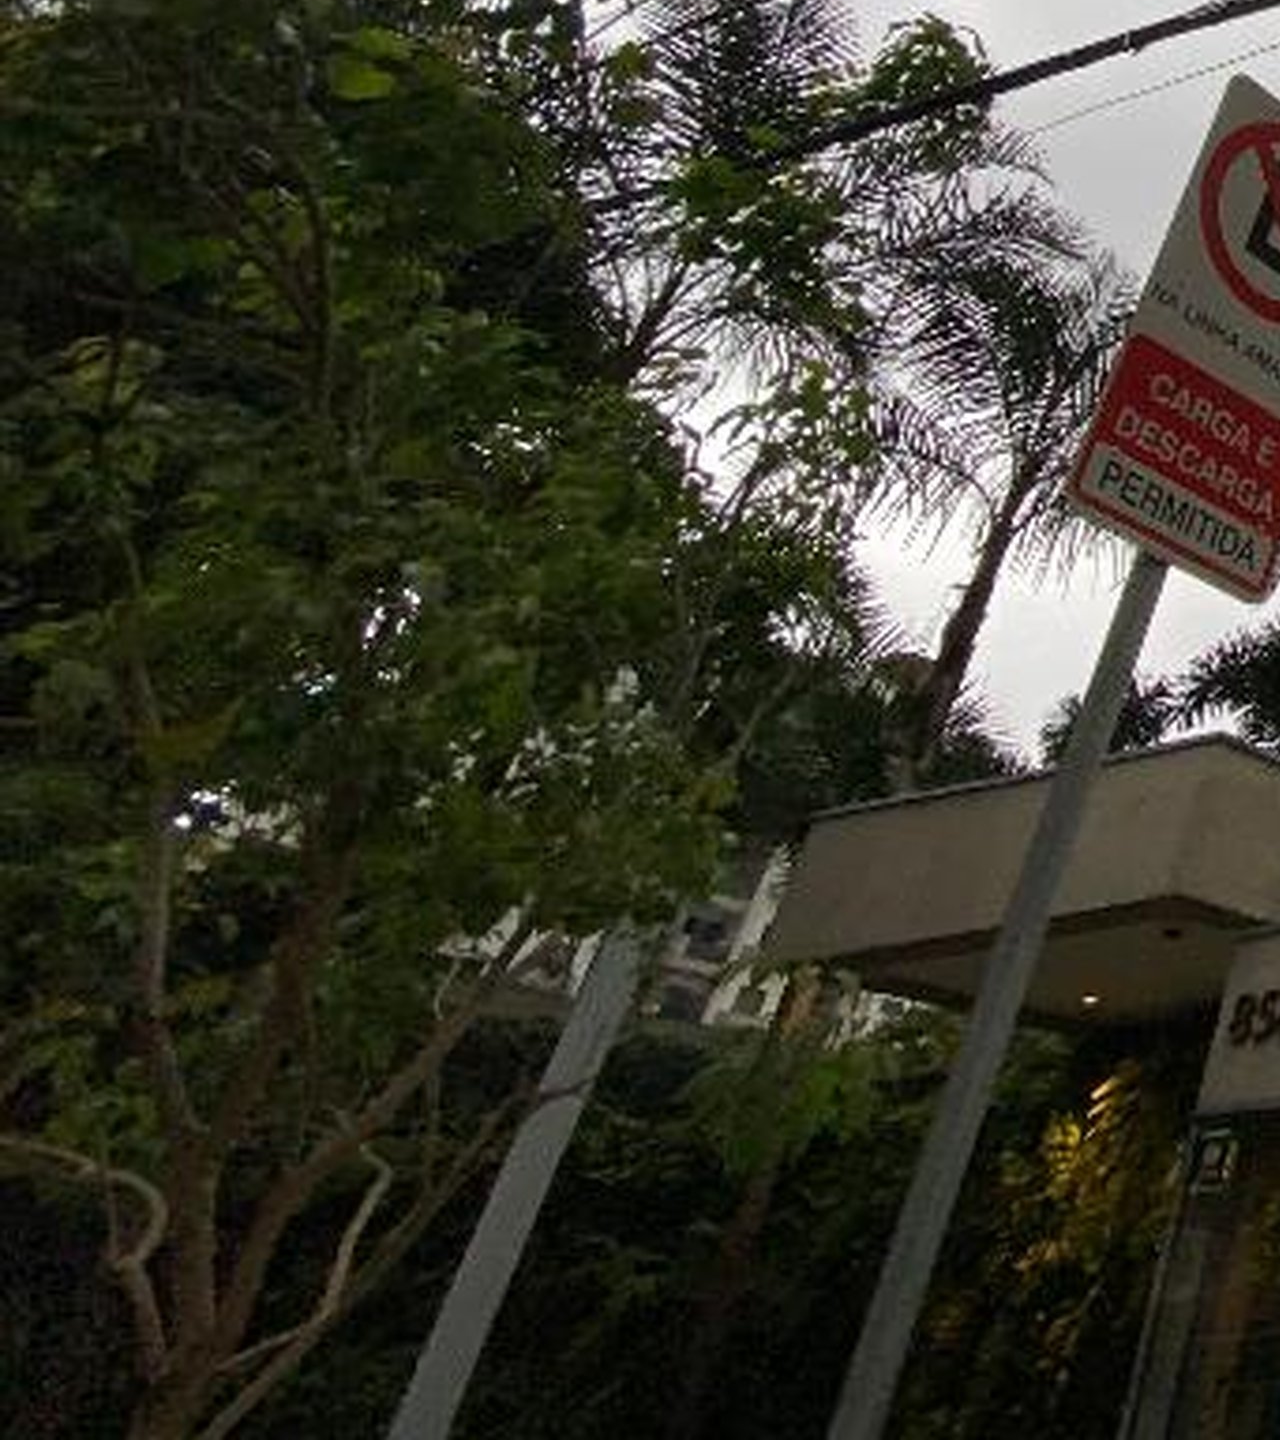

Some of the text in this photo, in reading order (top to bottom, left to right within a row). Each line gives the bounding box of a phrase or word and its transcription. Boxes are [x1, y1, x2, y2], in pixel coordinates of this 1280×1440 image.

[1113, 407, 1274, 522] DESCARGA
[1151, 373, 1280, 469] CARGA E
[1098, 460, 1258, 570] PERMITIDA
